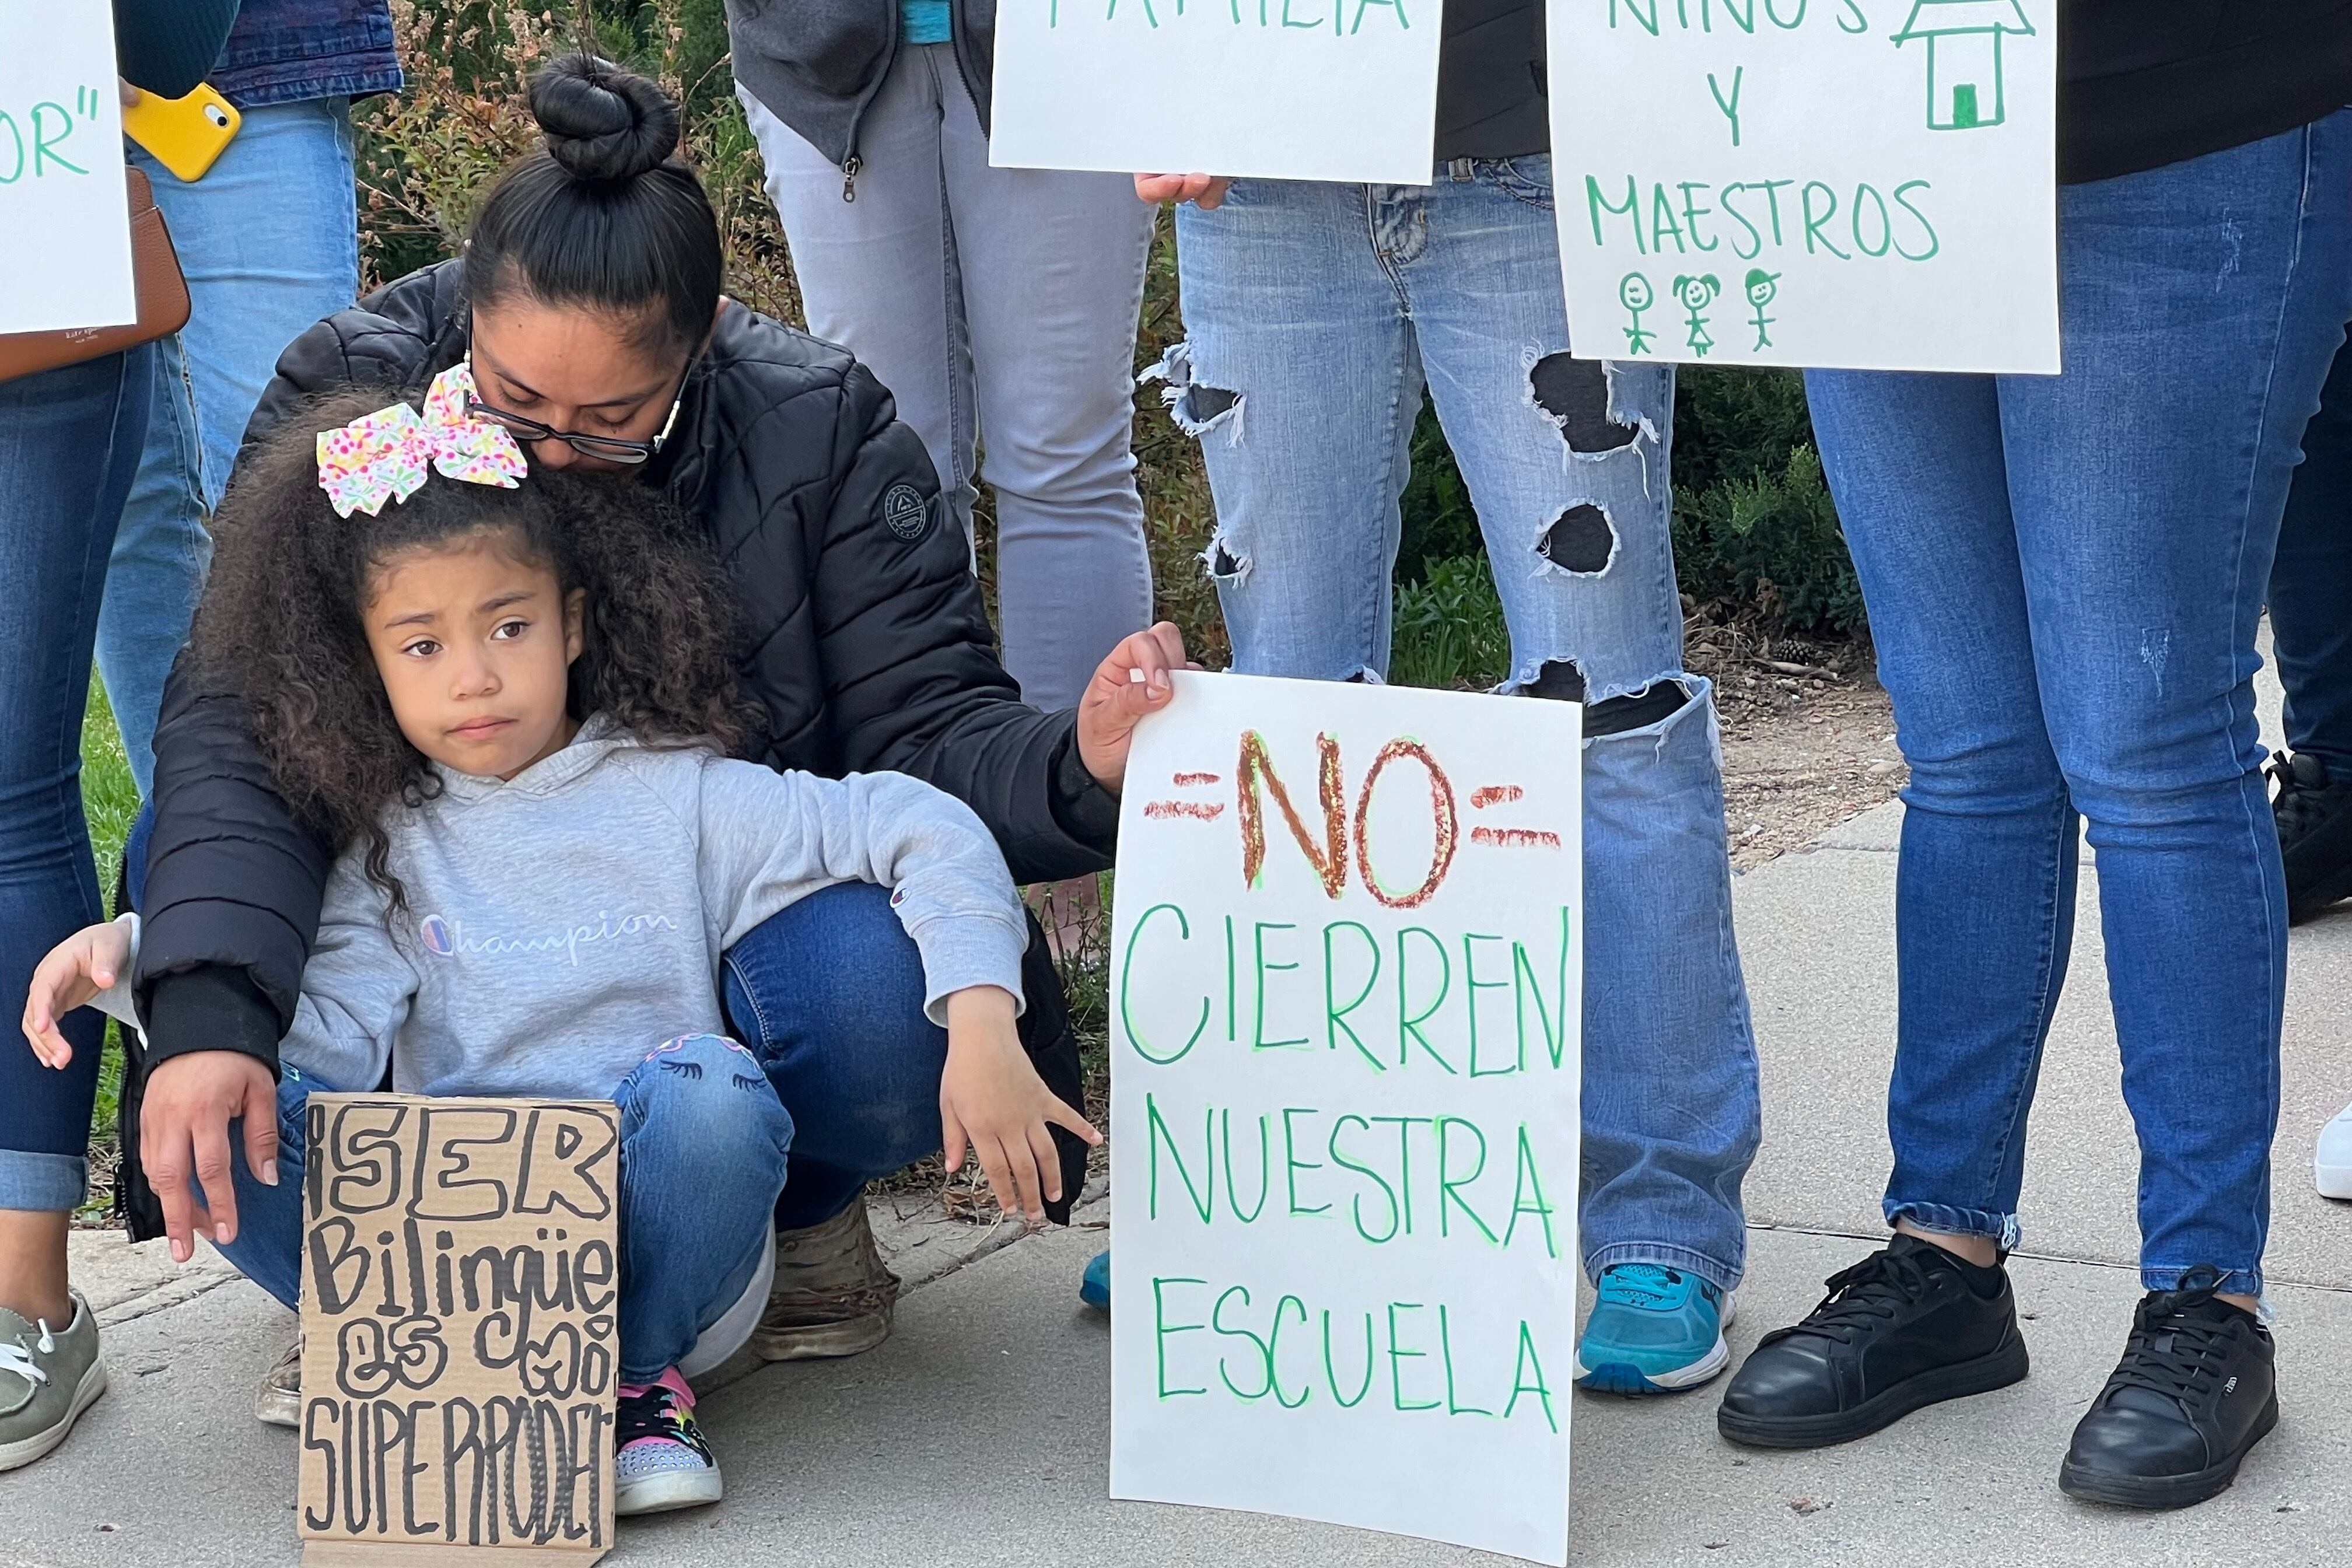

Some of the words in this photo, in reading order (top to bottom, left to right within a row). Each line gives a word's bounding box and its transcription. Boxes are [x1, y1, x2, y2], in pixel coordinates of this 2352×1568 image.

[1707, 65, 1744, 147] Y
[1585, 174, 1940, 261] MAESTROS
[420, 909, 678, 967] Champion
[1121, 903, 1570, 1078] CIERREN
[1144, 1092, 1563, 1260] NUESTRA
[1150, 1276, 1559, 1434] ESCUELA
